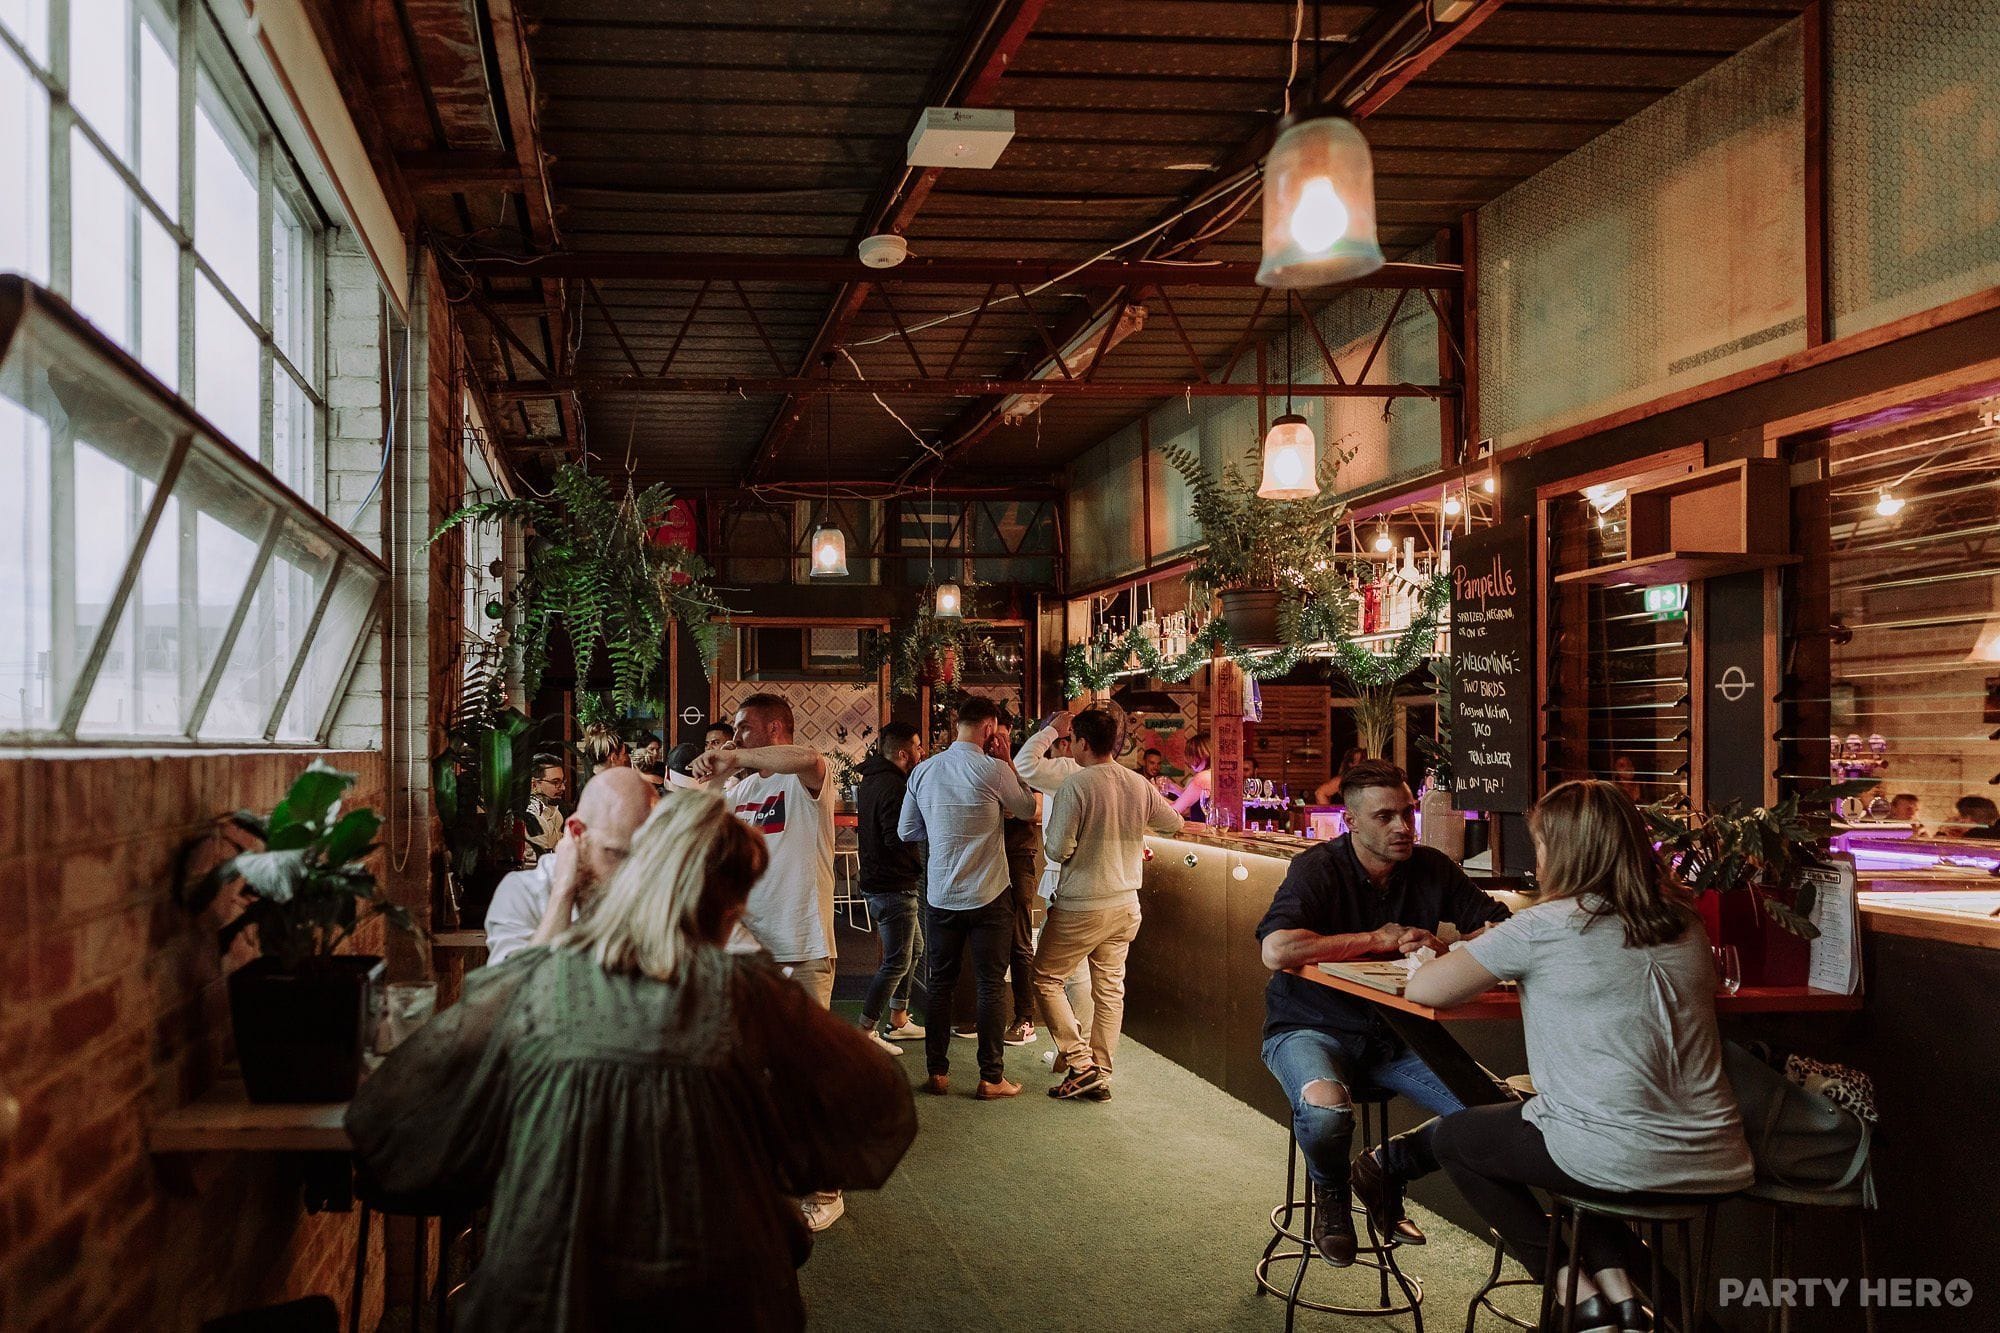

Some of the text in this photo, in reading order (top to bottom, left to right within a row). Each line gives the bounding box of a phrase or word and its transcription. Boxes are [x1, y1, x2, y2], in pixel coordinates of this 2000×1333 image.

[1452, 553, 1516, 612] Pampelle
[1466, 628, 1476, 639] ON
[1462, 678, 1506, 698] TWO BIRDS
[1471, 722, 1492, 738] TACO
[1455, 776, 1468, 793] ALL
[1469, 776, 1480, 789] ON
